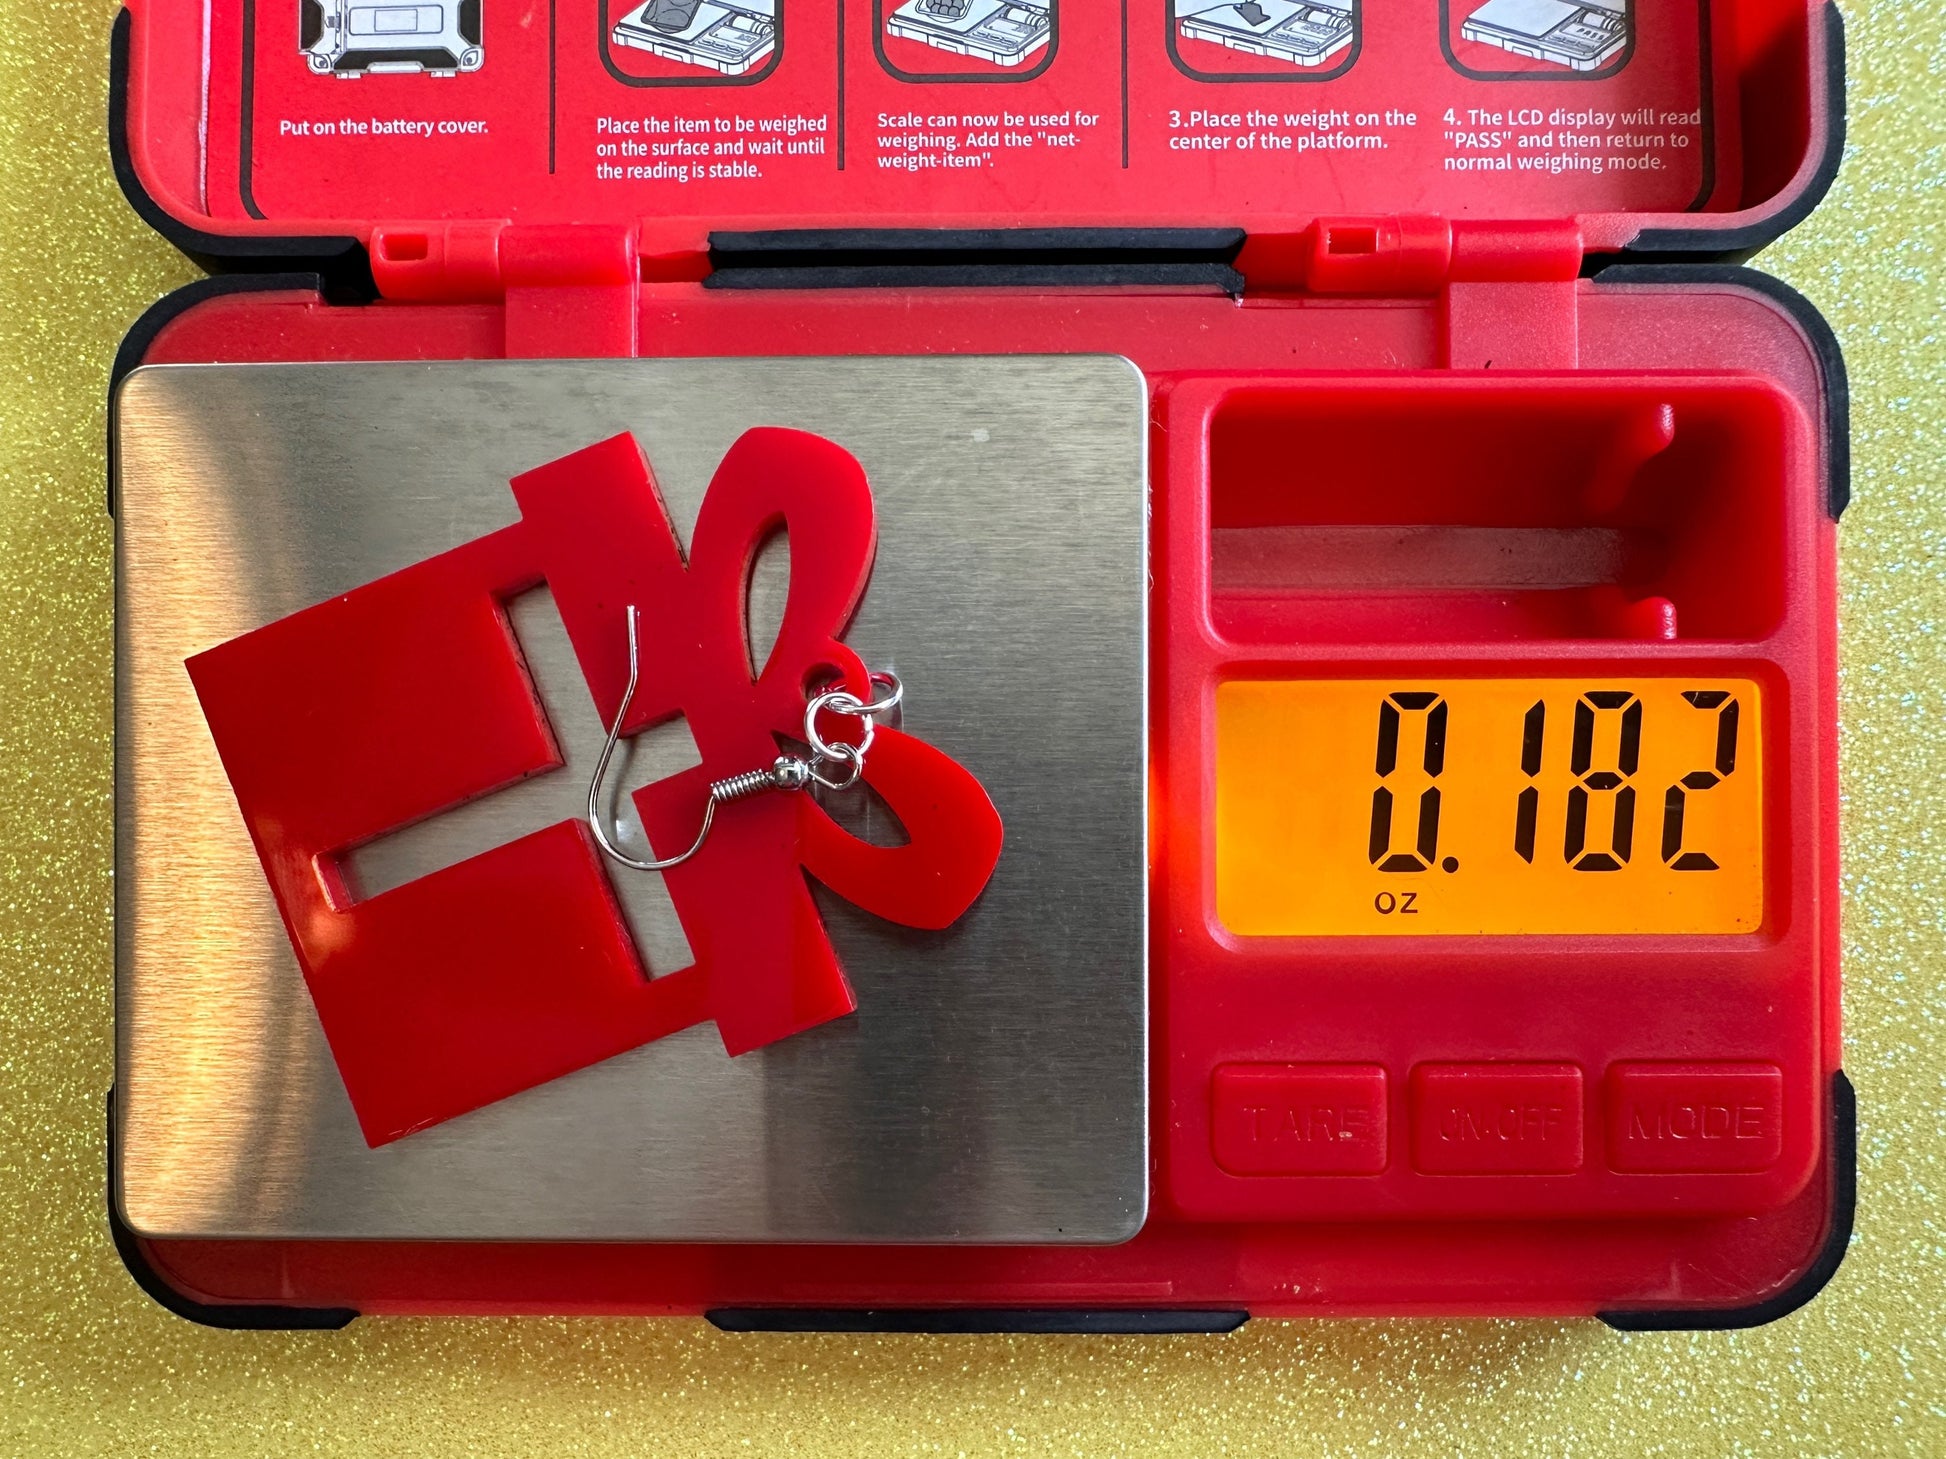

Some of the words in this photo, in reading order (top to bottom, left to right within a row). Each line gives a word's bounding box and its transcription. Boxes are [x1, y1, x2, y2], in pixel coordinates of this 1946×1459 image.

[279, 119, 311, 137] Put
[312, 121, 336, 136] on
[337, 117, 369, 136] the
[370, 117, 435, 139] battery
[437, 120, 489, 135] cover.
[596, 115, 640, 135] Place
[642, 115, 671, 134] the
[673, 114, 711, 133] item
[713, 116, 732, 133] to
[734, 114, 756, 133] be
[758, 113, 828, 137] weighed
[877, 111, 924, 128] Scale
[926, 115, 958, 128] can
[961, 114, 1000, 127] now
[1003, 110, 1025, 127] be
[1028, 110, 1070, 127] used
[1074, 110, 1101, 127] for
[1168, 109, 1242, 129] 3.Place
[1245, 108, 1279, 128] the
[1282, 108, 1351, 131] weight
[1354, 112, 1380, 127] on
[1384, 108, 1418, 127] the
[1442, 107, 1463, 127] 4.
[1466, 107, 1503, 126] The
[1507, 108, 1544, 126] LCD
[1548, 107, 1617, 130] display
[1620, 107, 1655, 126] will
[1659, 107, 1700, 126] read
[595, 143, 617, 158] on
[620, 138, 648, 157] the
[651, 137, 710, 157] surface
[713, 137, 744, 156] and
[747, 137, 784, 156] wait
[787, 136, 826, 156] until
[876, 131, 961, 152] weighing.
[965, 131, 1000, 148] Add
[1003, 130, 1033, 148] the
[1037, 130, 1081, 147] "net-
[1169, 133, 1232, 150] center
[1235, 131, 1257, 150] of
[1259, 131, 1293, 150] the
[1297, 130, 1389, 154] platform.
[1443, 130, 1512, 149] "PASS"
[1517, 130, 1553, 148] and
[1557, 130, 1601, 148] then
[1606, 132, 1665, 148] return
[1669, 132, 1690, 148] to
[595, 161, 624, 180] the
[626, 160, 689, 184] reading
[691, 160, 706, 179] is
[708, 159, 763, 179] stable.
[876, 151, 994, 173] weight-item".
[1444, 152, 1513, 171] normal
[1516, 152, 1604, 175] weighing
[1607, 152, 1667, 170] mode.
[1369, 691, 1740, 873] 0.182
[1243, 1107, 1370, 1143] TARE
[1628, 1105, 1765, 1140] MODE
